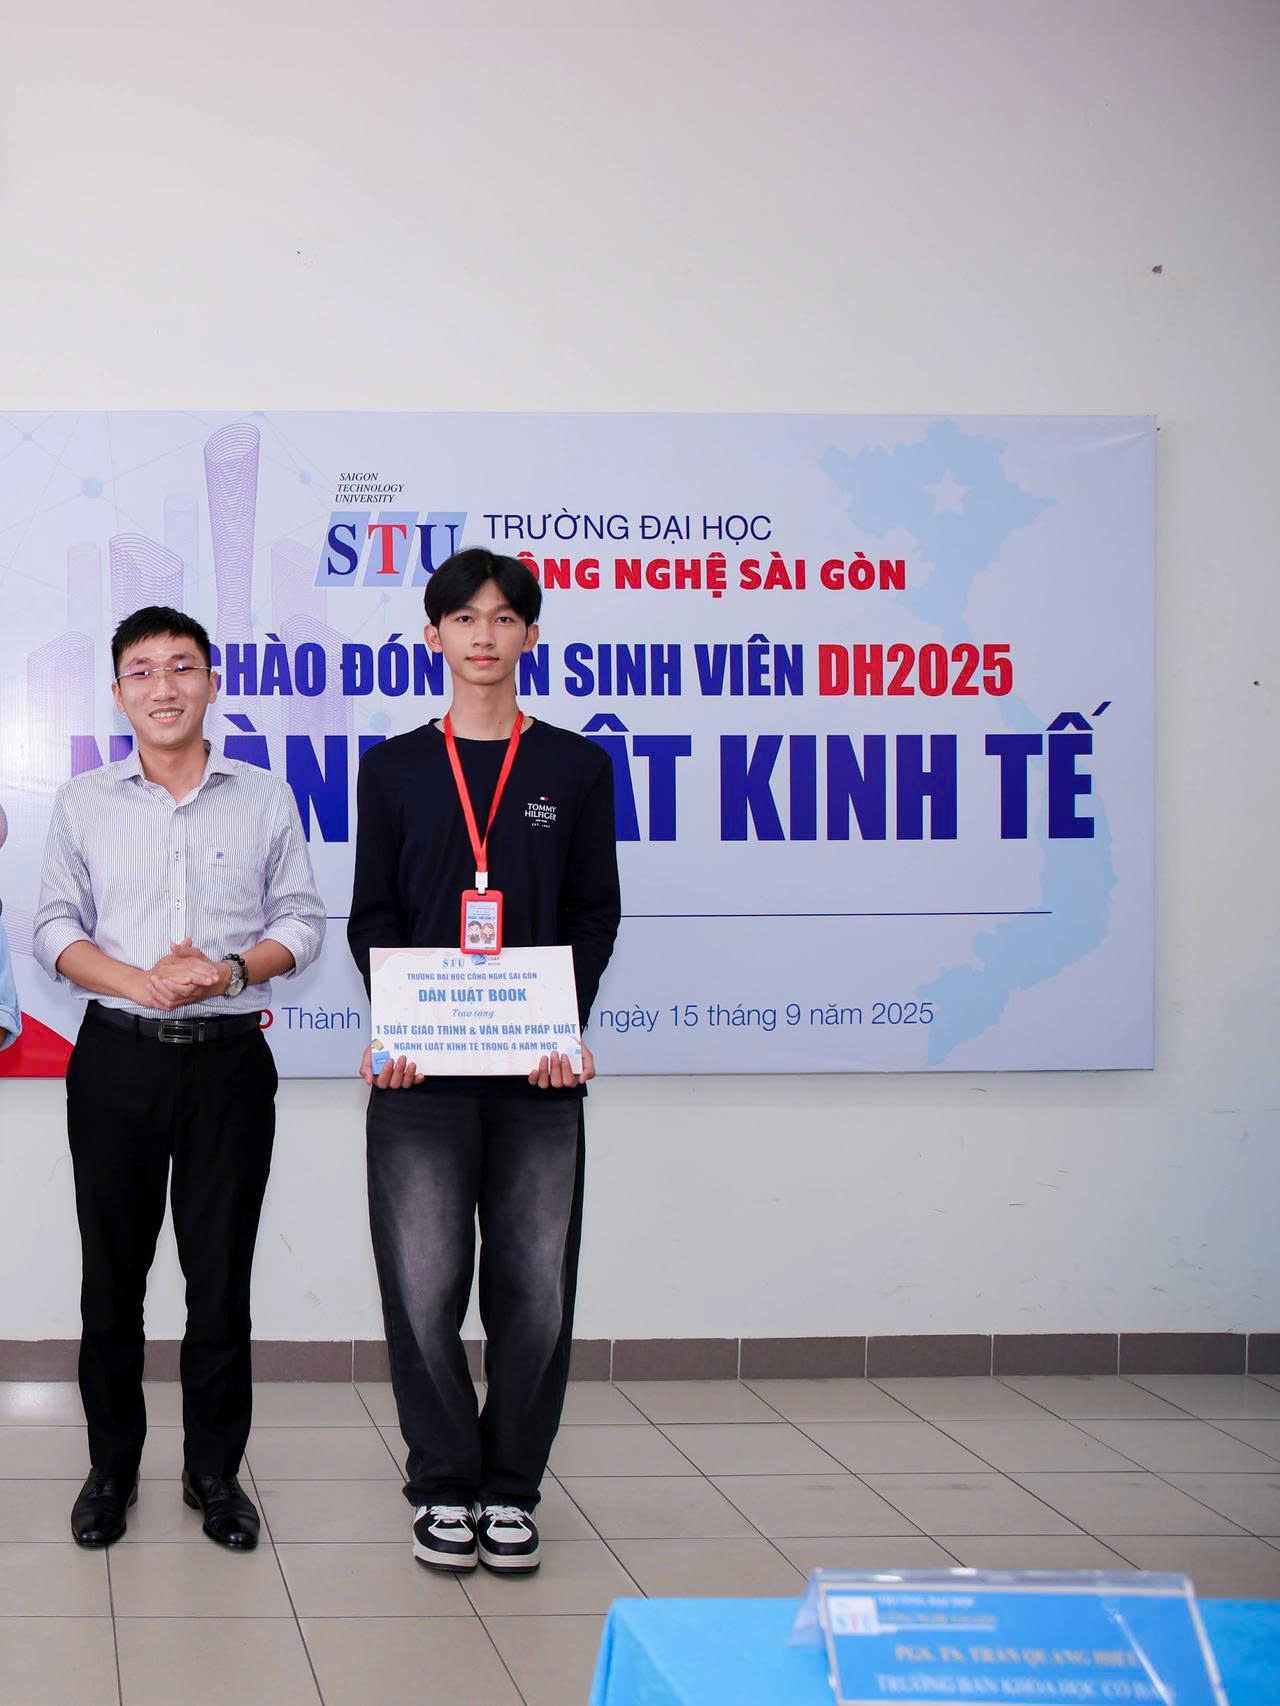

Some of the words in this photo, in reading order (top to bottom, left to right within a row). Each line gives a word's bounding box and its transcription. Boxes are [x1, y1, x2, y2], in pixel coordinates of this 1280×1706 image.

[339, 472, 378, 481] SAIGON
[337, 484, 405, 493] TECHNOLOGY
[335, 494, 396, 503] UNIVERSITY
[483, 507, 629, 540] TRƯỜNG
[639, 514, 690, 544] ĐẠI
[703, 514, 772, 546] HỌC
[327, 523, 459, 575] STU
[517, 551, 600, 590] NG
[615, 552, 727, 598] NGHỆ
[739, 552, 805, 590] SÀI
[820, 552, 906, 590] GÒN
[340, 633, 444, 697] ĐÓN
[564, 642, 682, 697] SINH
[694, 633, 804, 697] VIÊN
[818, 643, 1014, 697] DH2025
[720, 735, 958, 841] KINH
[984, 701, 1112, 840] TẾ
[524, 810, 556, 821] HILFIGER
[527, 803, 556, 813] TOMMY
[443, 959, 464, 967] STU
[418, 987, 446, 1002] DÂN
[450, 987, 484, 1004] LUẬT
[488, 988, 527, 1002] BOOK
[281, 1006, 360, 1030] Thành
[600, 1004, 659, 1033] ngày
[670, 1004, 698, 1027] 15
[707, 1003, 777, 1032] tháng
[786, 1003, 801, 1026] 9
[810, 1003, 862, 1025] năm
[871, 1002, 934, 1025] 2025
[469, 1026, 476, 1035] &
[447, 1042, 466, 1051] KINH
[480, 1042, 508, 1050] TRONG
